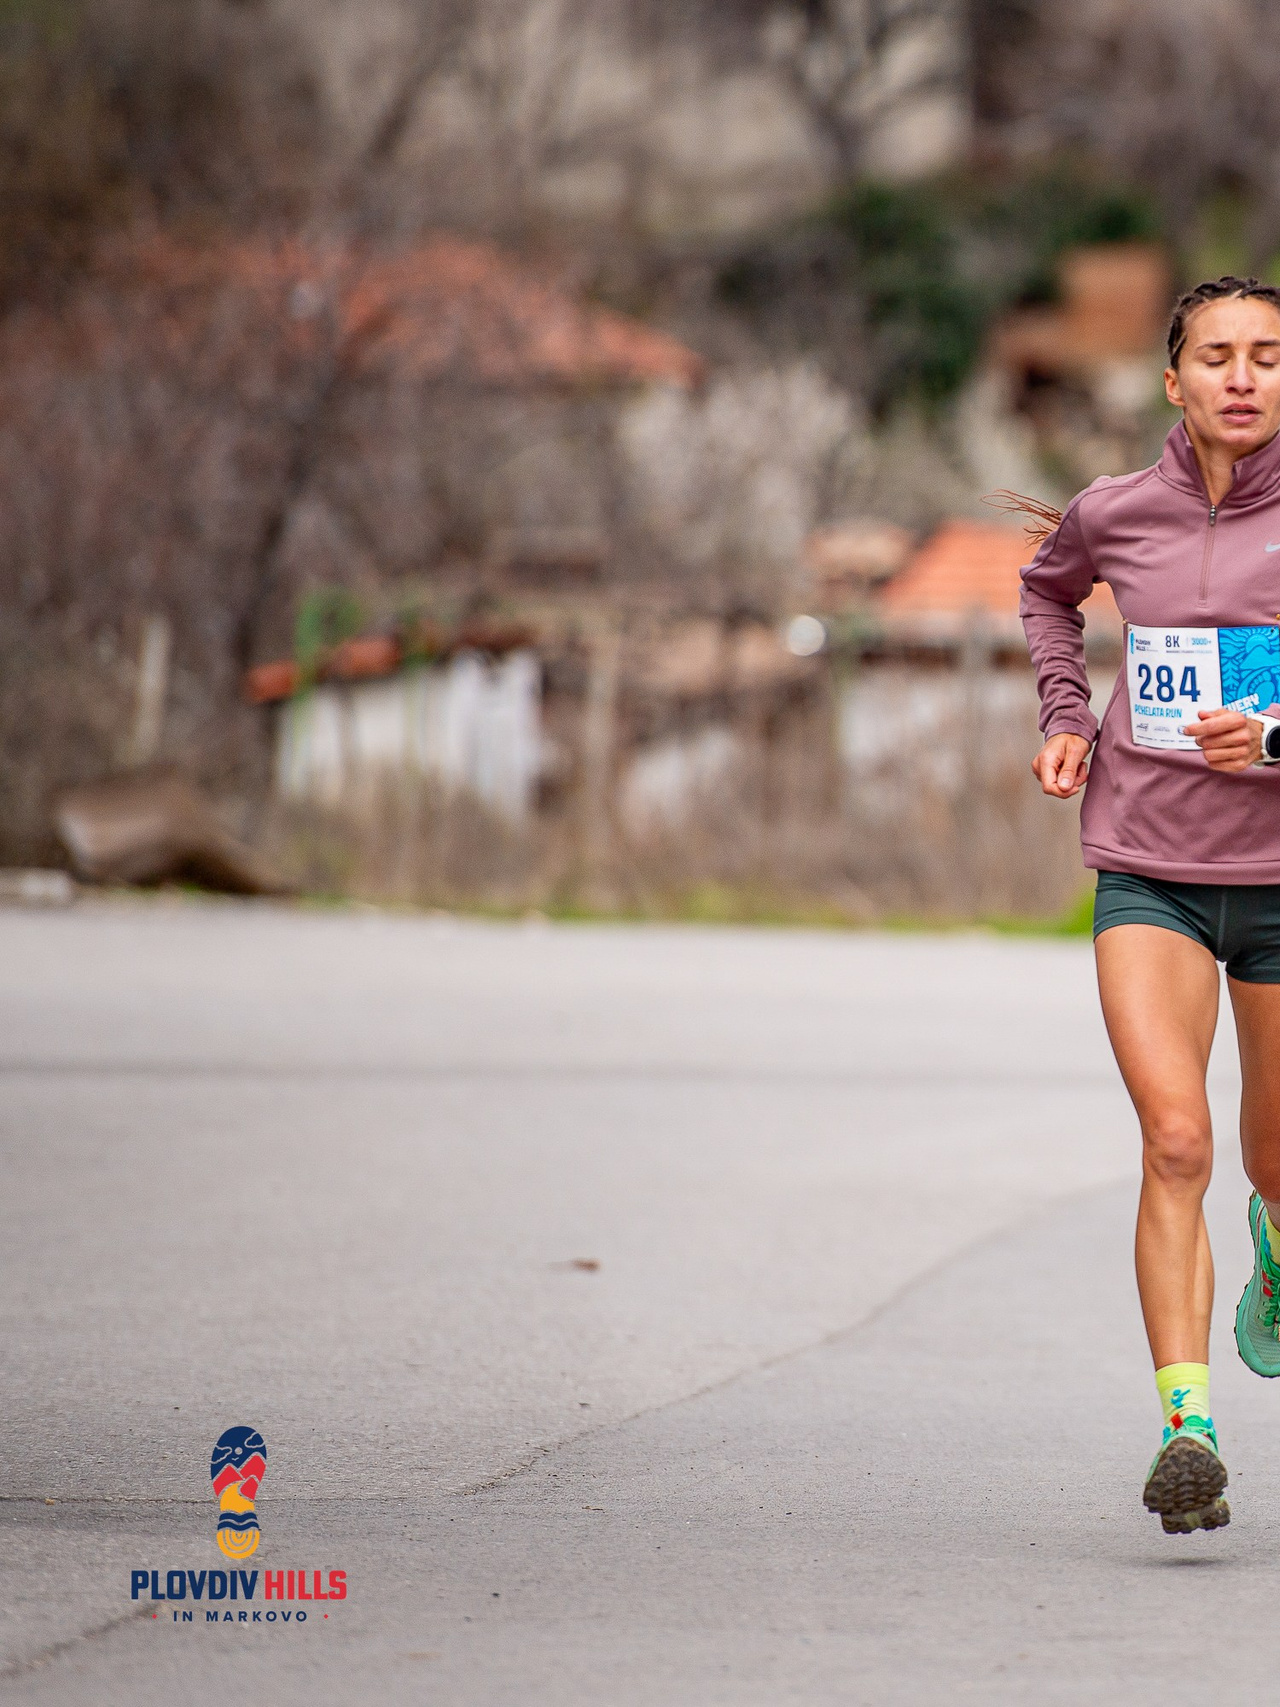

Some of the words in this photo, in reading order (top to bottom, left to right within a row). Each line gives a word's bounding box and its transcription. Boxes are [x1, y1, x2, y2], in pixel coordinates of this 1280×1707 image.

[1165, 635, 1180, 648] 8K
[1138, 663, 1201, 703] 284
[1165, 707, 1183, 718] RUN
